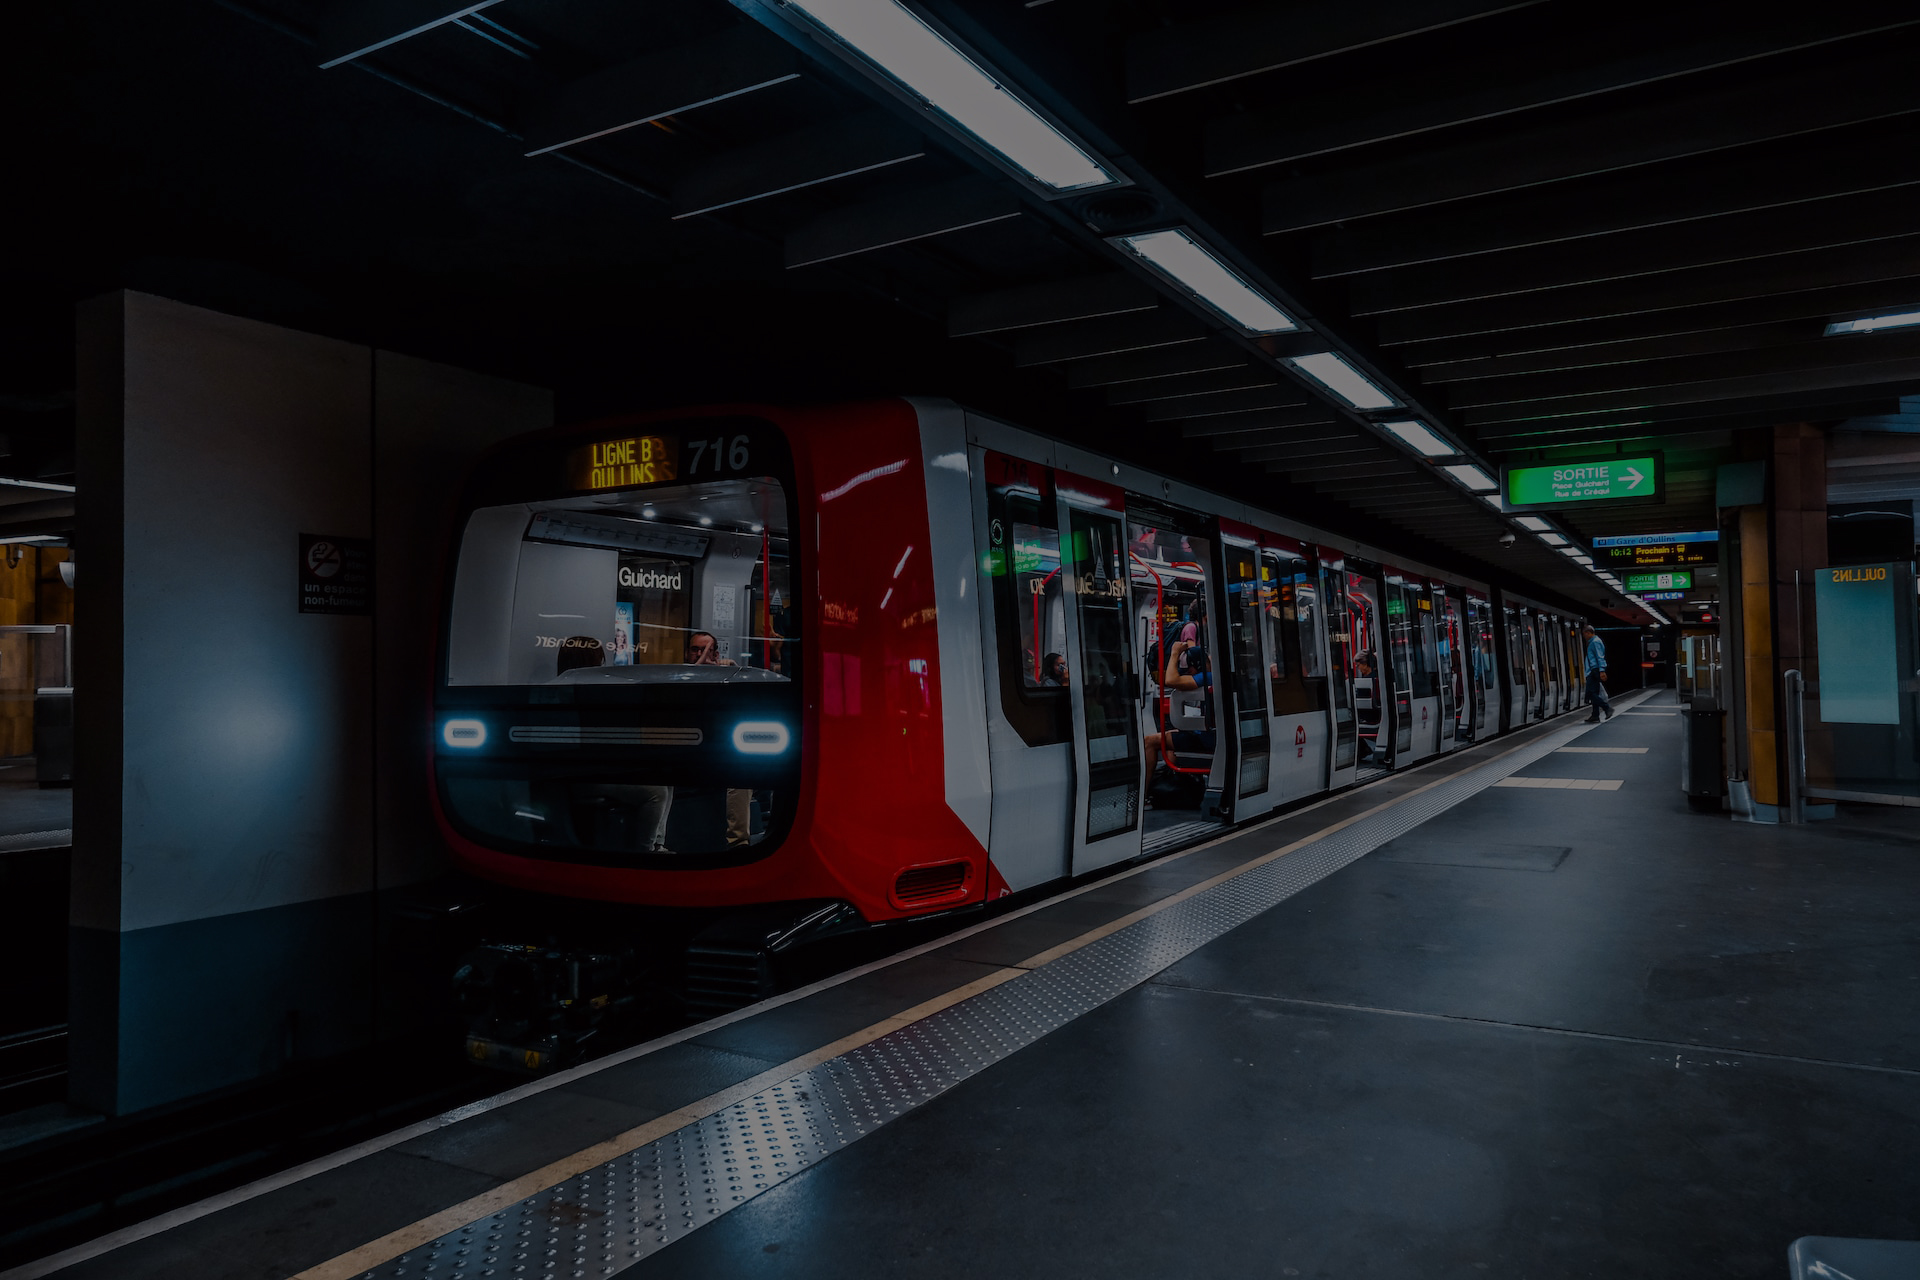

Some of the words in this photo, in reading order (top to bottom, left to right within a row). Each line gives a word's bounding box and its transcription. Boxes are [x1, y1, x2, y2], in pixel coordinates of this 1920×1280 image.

[592, 440, 636, 468] LIGNE
[641, 438, 652, 463] B
[688, 434, 750, 475] 716
[1553, 466, 1610, 482] SORTIE
[1575, 480, 1610, 488] Guichard
[1638, 536, 1676, 544] d'Oullins
[343, 546, 367, 559] Vous
[1610, 547, 1632, 557] 10:12
[1635, 546, 1669, 555] Prochain
[344, 571, 367, 583] dans
[618, 566, 682, 591] Guichard
[304, 583, 320, 593] un
[323, 584, 367, 596] espace
[304, 595, 366, 607] non-fumeur
